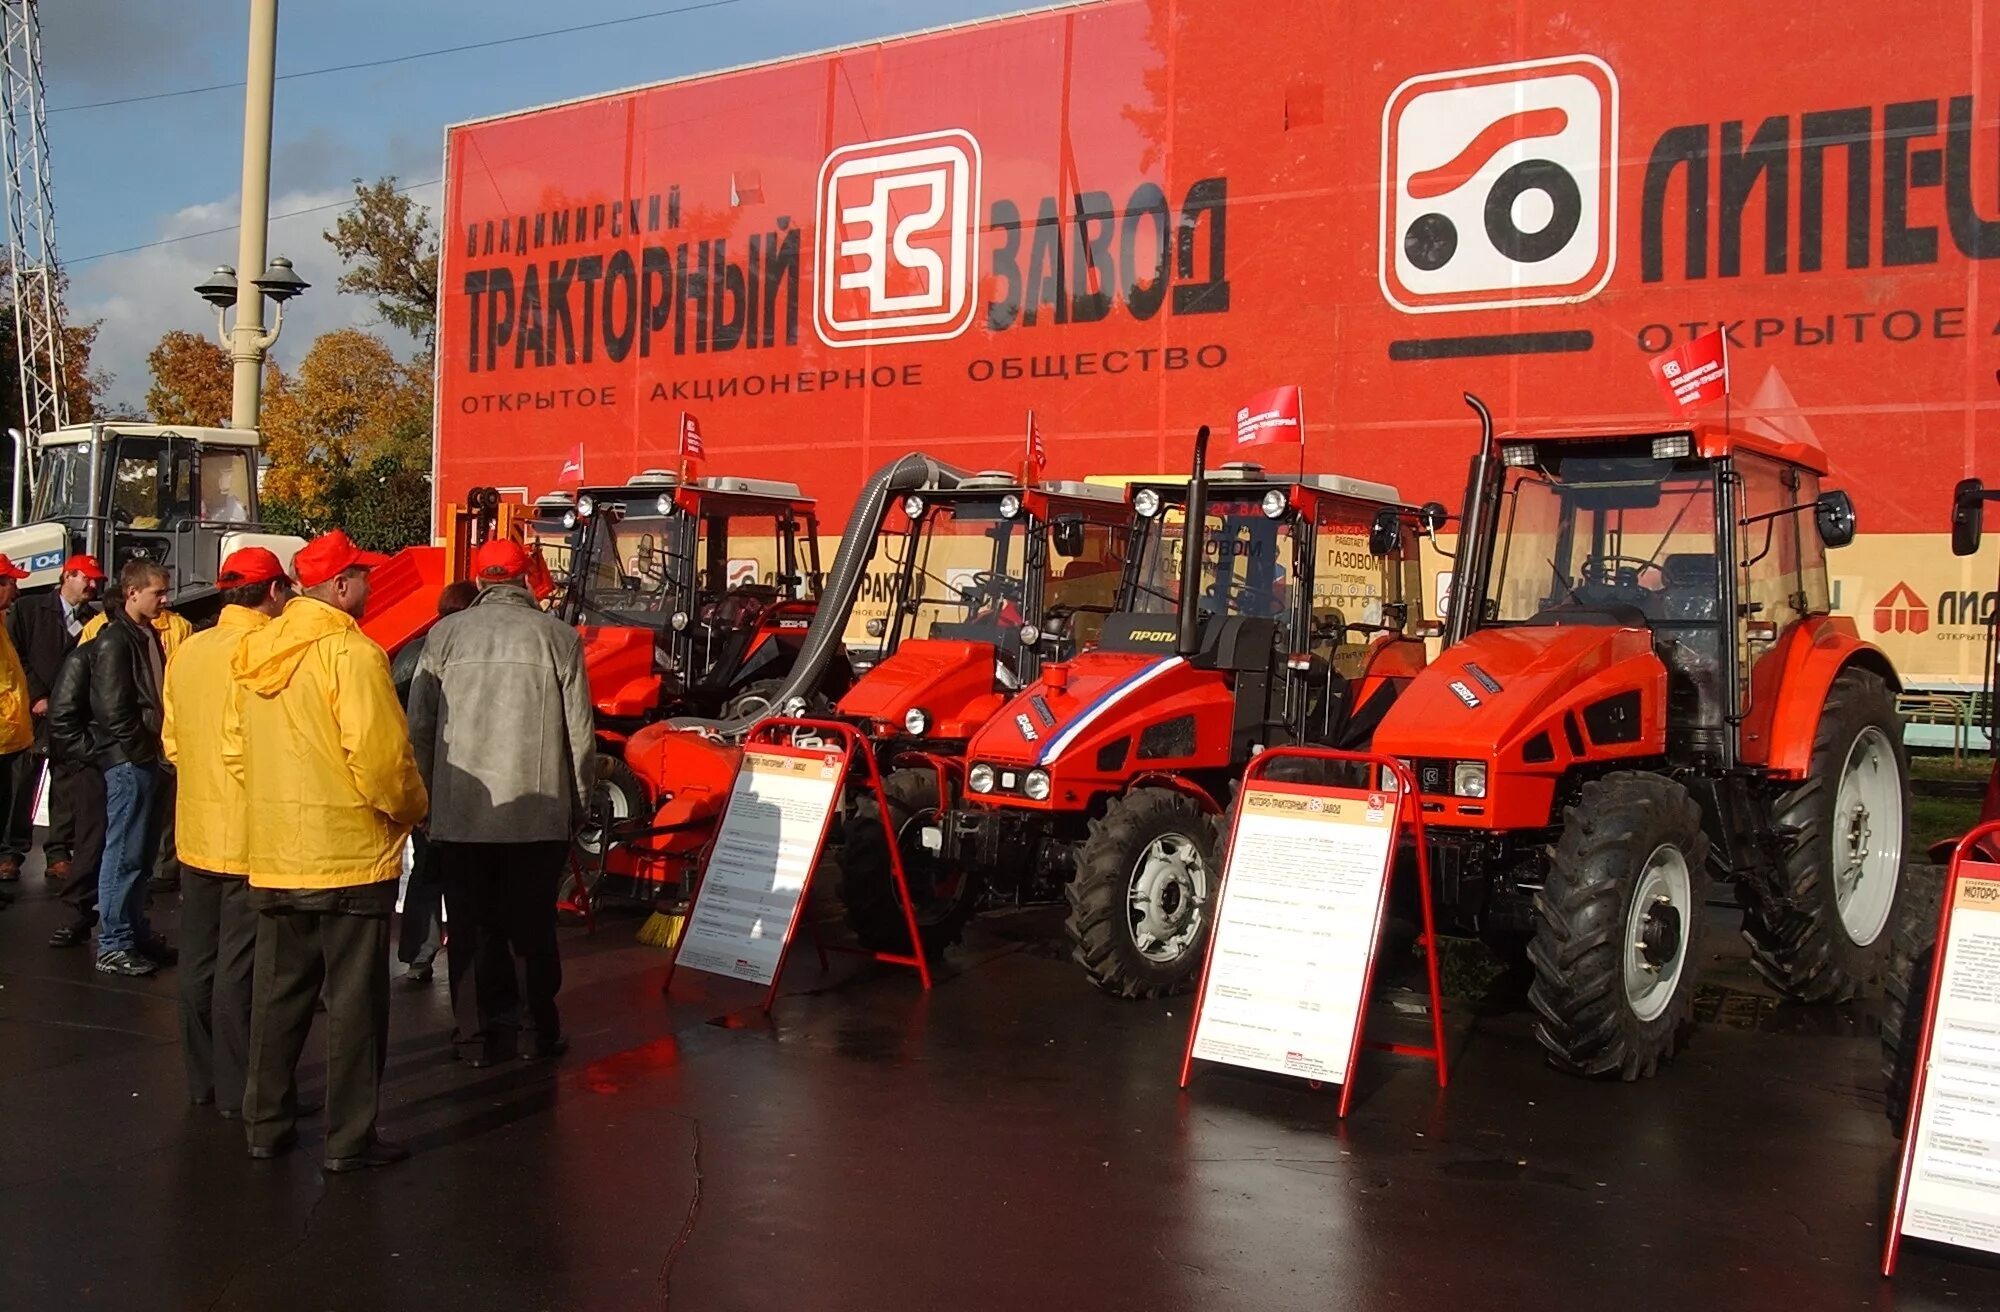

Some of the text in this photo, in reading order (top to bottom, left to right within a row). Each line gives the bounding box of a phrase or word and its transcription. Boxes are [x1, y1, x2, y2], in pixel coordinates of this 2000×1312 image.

[467, 184, 682, 258] ВЛАДИМИРСКИЙ
[464, 176, 1230, 373] ТРАКТОРНЫЙ ЗАВОД
[1637, 306, 1966, 355] ОТКРЫТОЕ
[461, 344, 1229, 414] ОТКРЫТОЕ АКЦИОНЕРНОЕ ОБЩЕСТВО
[1328, 549, 1382, 572] ГАЗОВОМ
